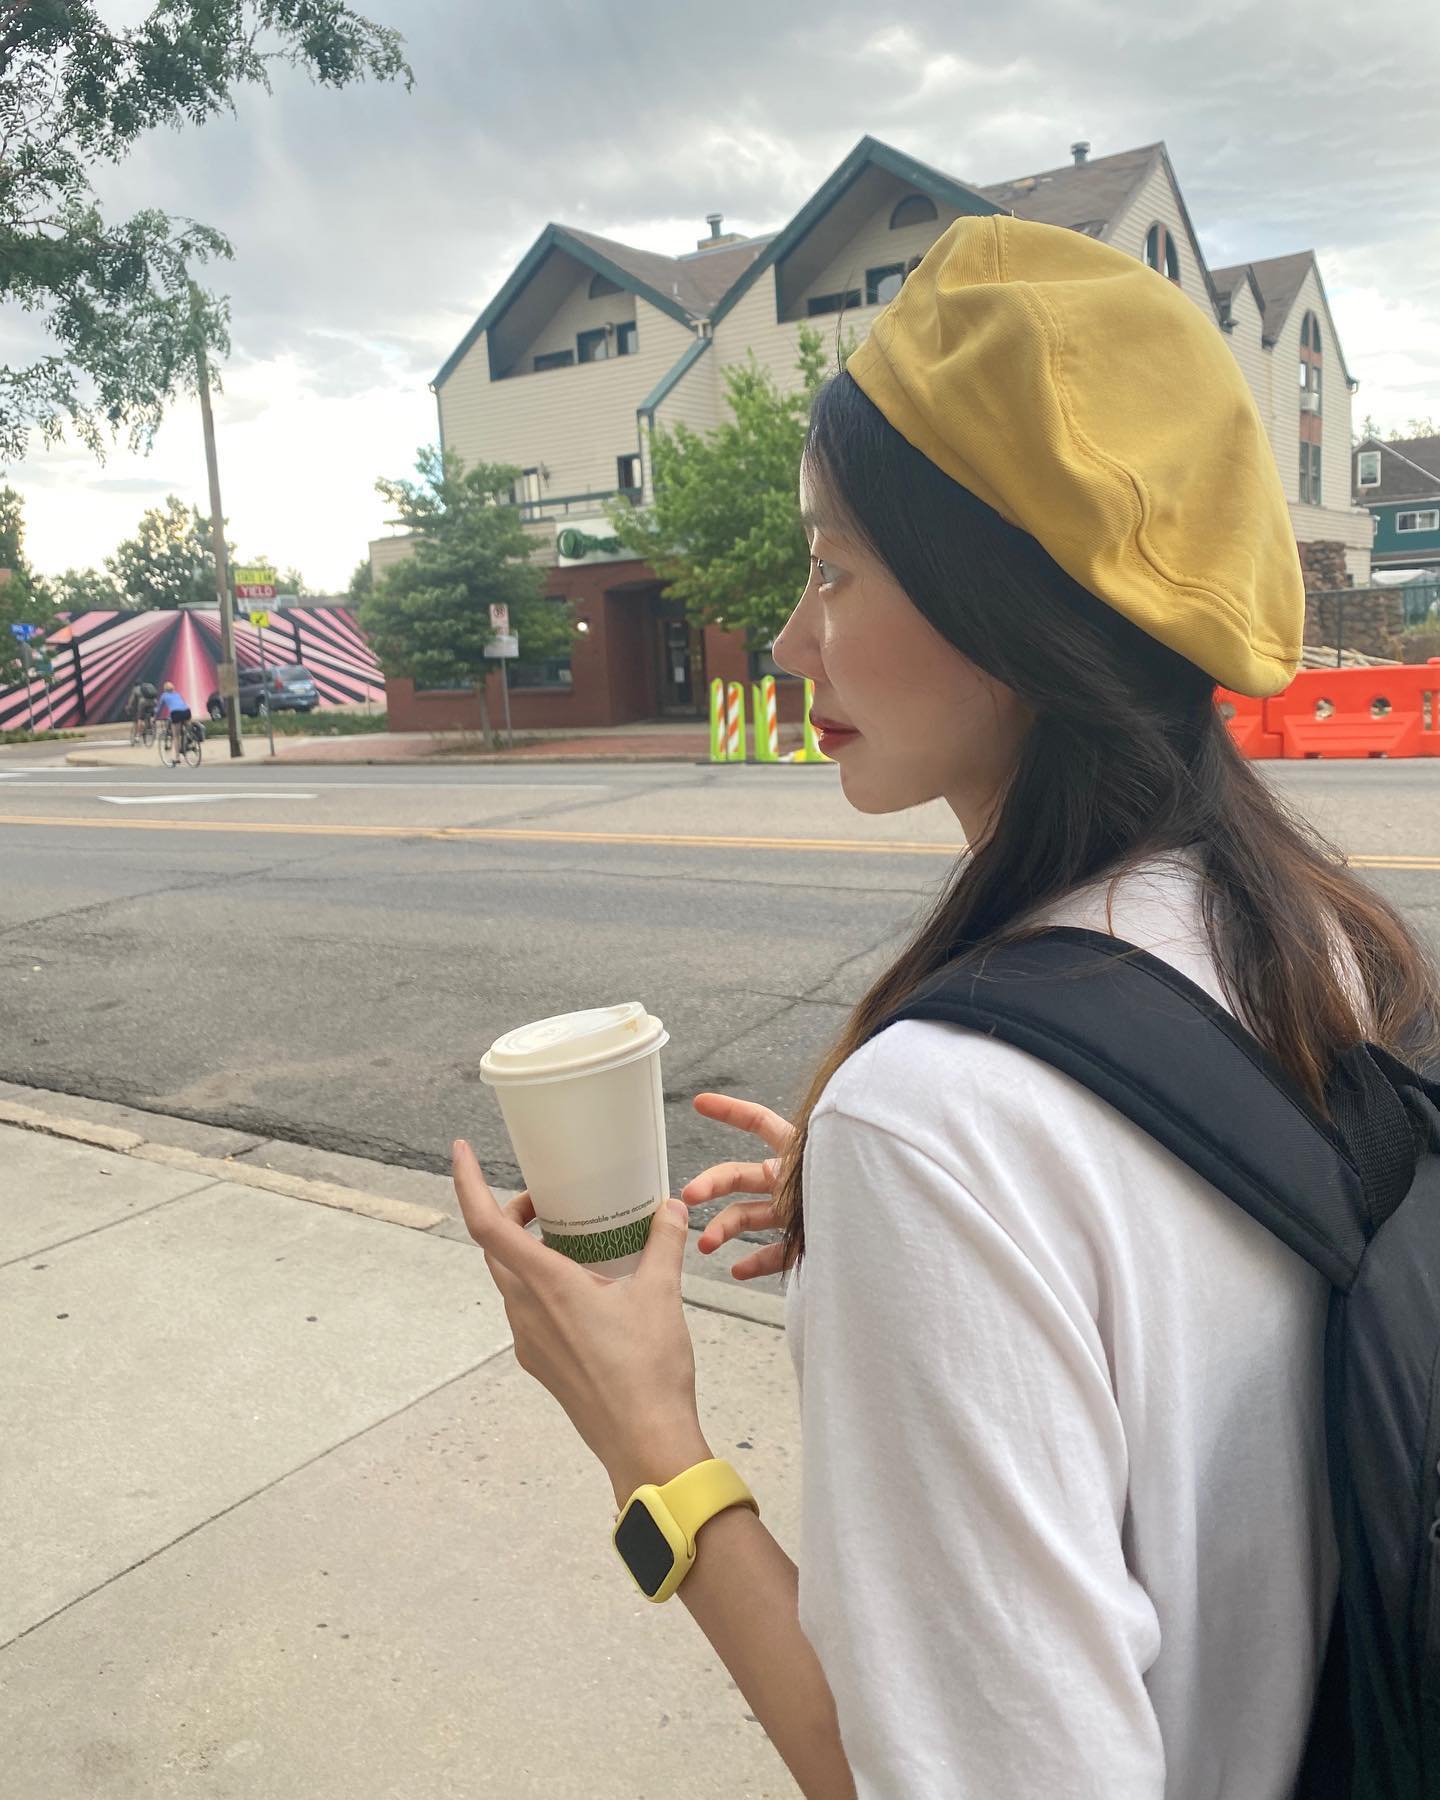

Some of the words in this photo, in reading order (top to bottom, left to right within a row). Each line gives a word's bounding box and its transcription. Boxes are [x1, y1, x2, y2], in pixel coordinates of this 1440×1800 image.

[240, 585, 273, 597] YIELD
[568, 1214, 609, 1226] compostable
[610, 1210, 630, 1220] where
